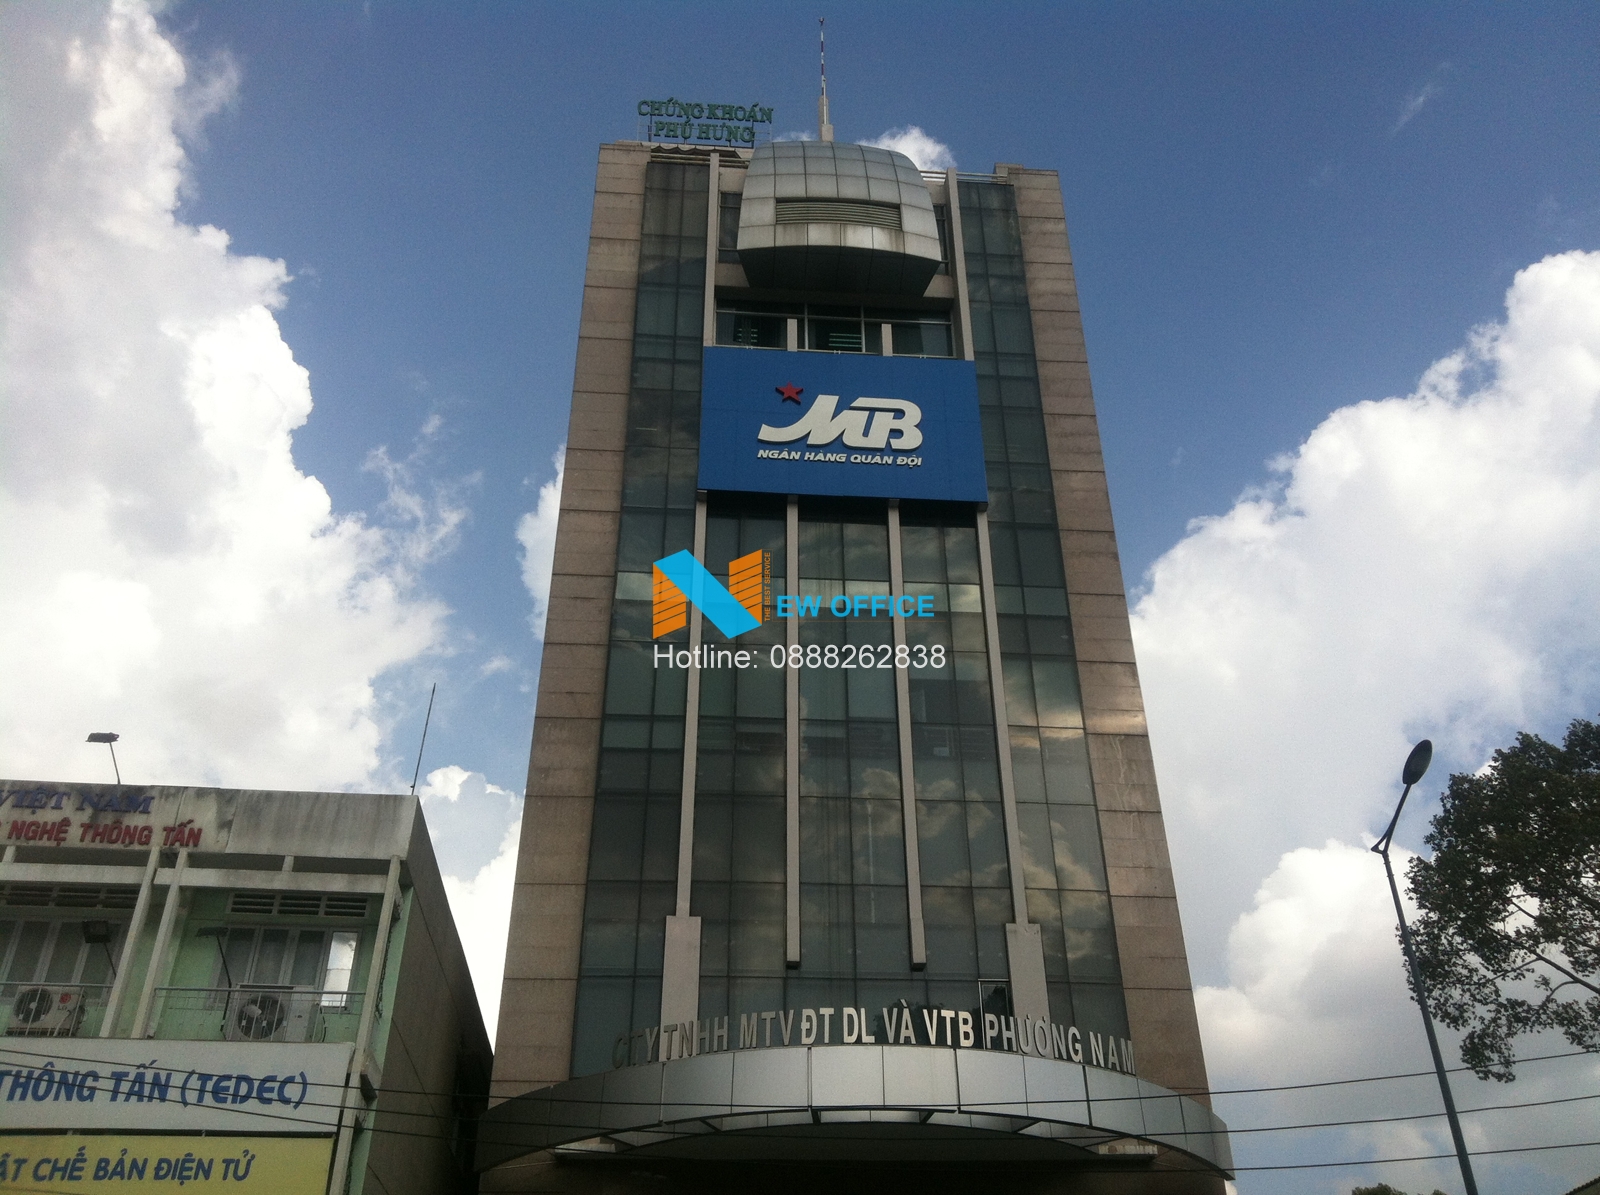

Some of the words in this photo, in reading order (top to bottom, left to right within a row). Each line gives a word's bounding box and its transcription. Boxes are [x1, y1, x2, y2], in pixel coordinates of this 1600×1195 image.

[637, 97, 705, 119] CHỨNG
[706, 102, 774, 124] KHOÁN
[653, 117, 694, 139] PHÚ
[697, 121, 755, 142] HƯNG
[757, 394, 924, 450] MB
[757, 448, 801, 461] NGÂN
[804, 449, 847, 463] HÀNG
[850, 452, 893, 465] QUÂN
[896, 454, 923, 468] ĐỘI
[75, 792, 155, 814] NAM
[7, 817, 72, 847] NGHỆ
[79, 819, 153, 846] THÔNG
[162, 818, 203, 847] TẤN
[663, 1015, 728, 1060] TNHH
[739, 1007, 795, 1049] MTV
[800, 1007, 836, 1045] ĐT
[842, 1007, 876, 1044] DL
[881, 999, 917, 1045] VÀ
[922, 1008, 976, 1048] VTB
[984, 1013, 1083, 1063] PHƯƠNG
[1089, 1031, 1136, 1076] NAM
[109, 1059, 173, 1103] TẤN
[181, 1069, 308, 1110] (TEDEC)
[32, 1145, 88, 1181] CHẾ
[93, 1147, 149, 1181] BẢN
[153, 1151, 214, 1187] ĐIỆN
[221, 1148, 256, 1181] TỬ
